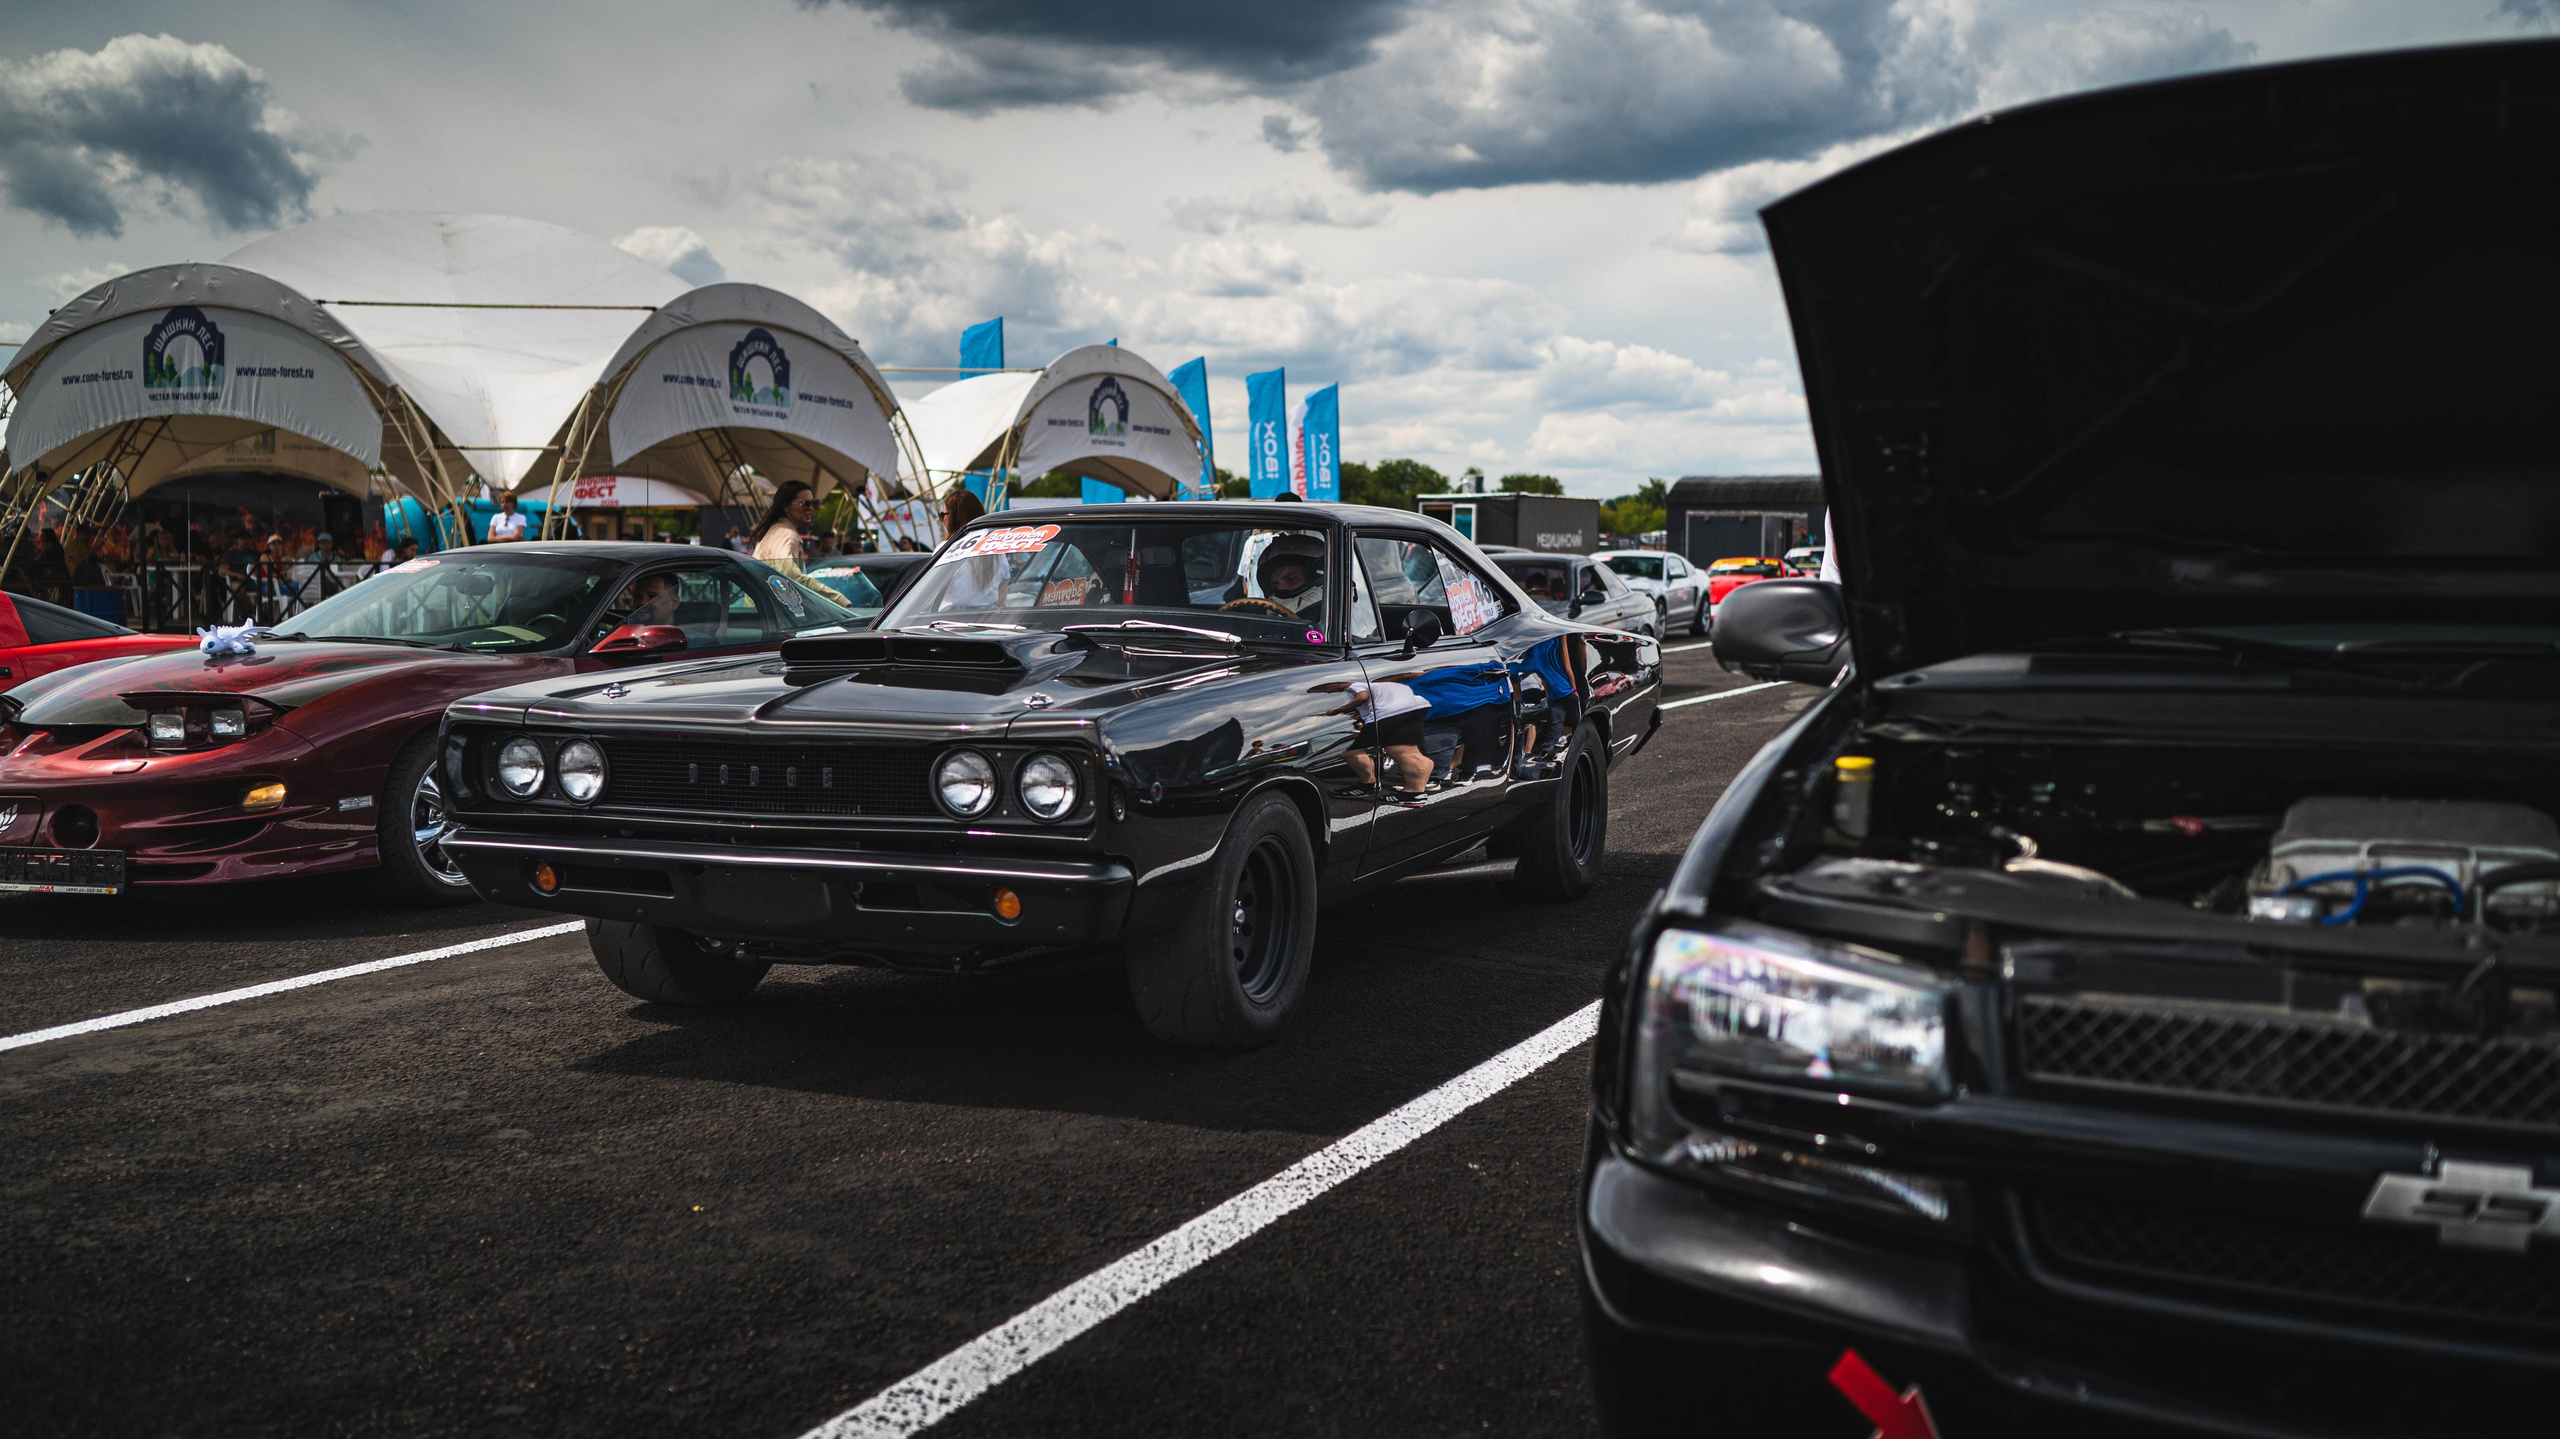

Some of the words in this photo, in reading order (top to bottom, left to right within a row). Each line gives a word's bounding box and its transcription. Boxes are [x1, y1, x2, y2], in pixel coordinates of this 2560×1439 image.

[153, 318, 196, 352] ШИШКИН
[196, 326, 214, 351] ЛЕС
[736, 341, 770, 369] ШИШКИН
[769, 351, 782, 374] ЛЕС
[62, 369, 133, 385] www.cone-forest.ru
[235, 365, 314, 379] www.cone-forest.ru
[575, 485, 616, 500] ФЕСТ
[981, 539, 1042, 551] ФЕСТ
[1474, 580, 1492, 606] 46
[689, 763, 833, 788] DODGE
